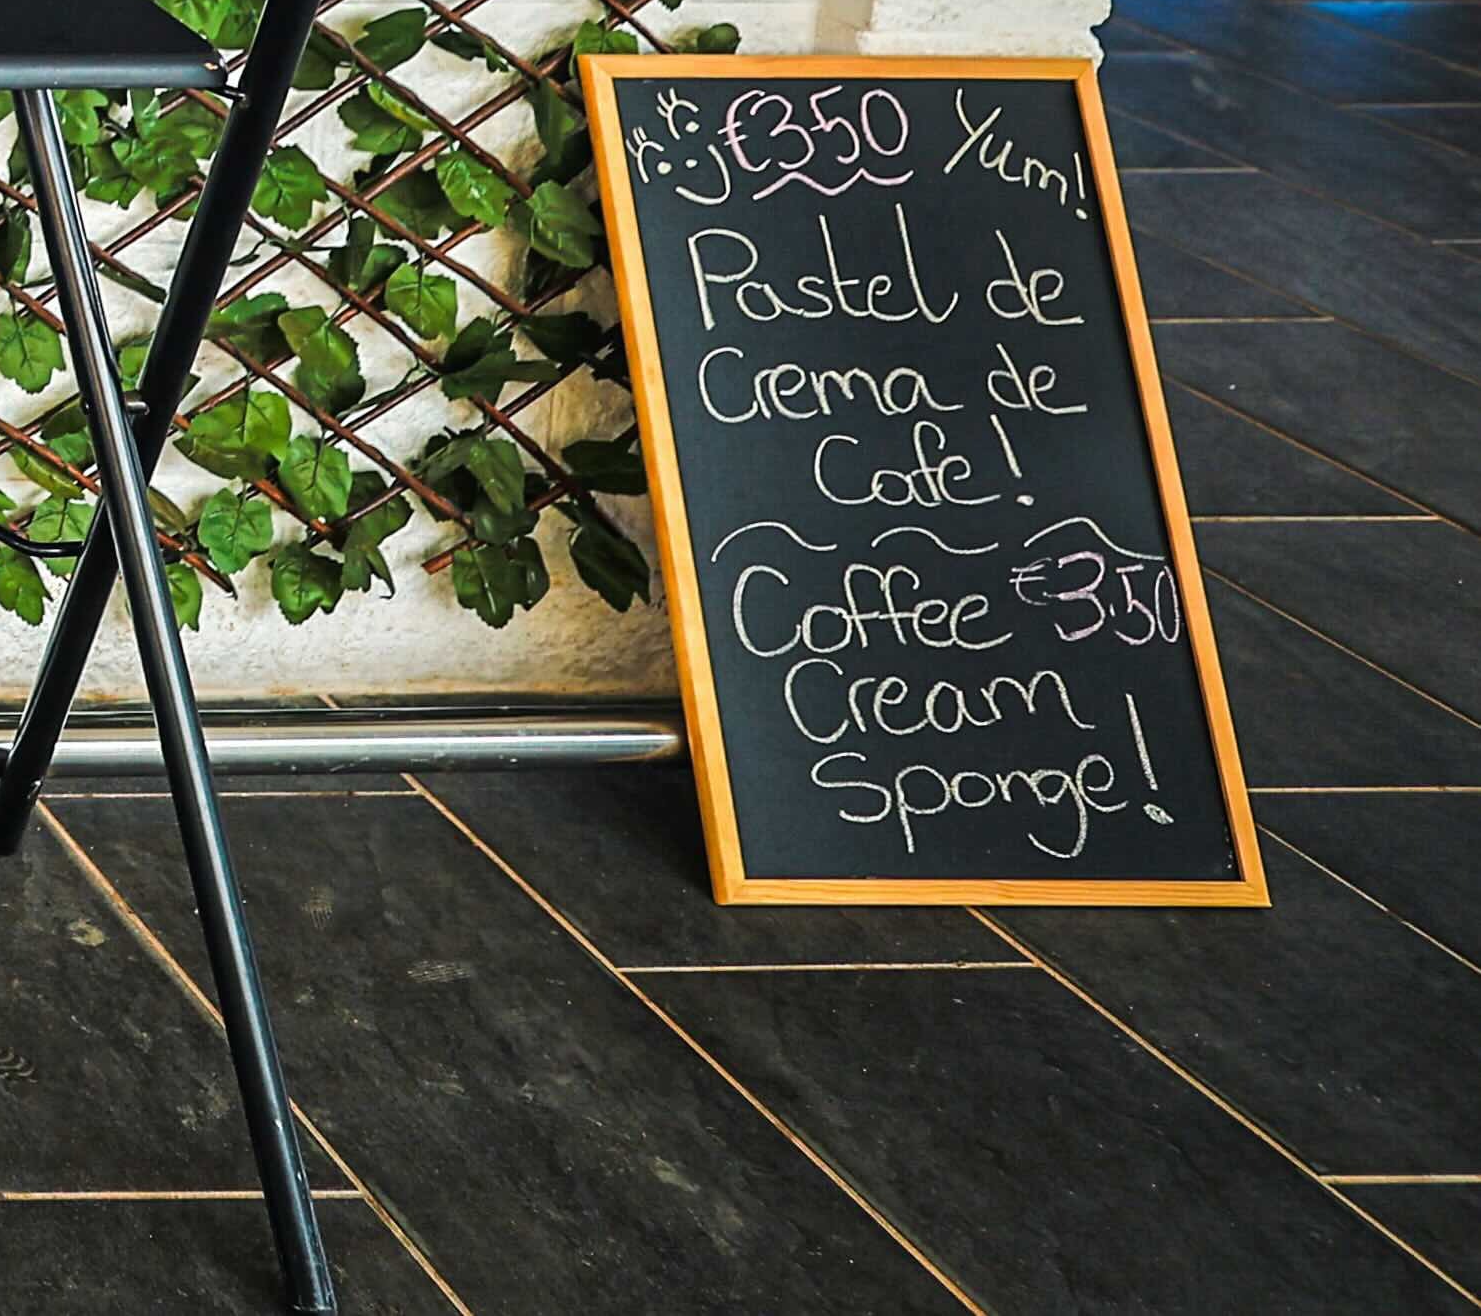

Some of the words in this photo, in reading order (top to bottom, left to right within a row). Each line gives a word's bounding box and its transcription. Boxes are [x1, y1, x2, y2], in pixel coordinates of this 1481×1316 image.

[943, 87, 1090, 221] Yum!
[686, 203, 959, 329] Pastel
[985, 230, 1085, 325] de
[697, 347, 963, 424] Crema
[986, 343, 1087, 413] de
[731, 564, 1012, 658] Coffee
[783, 659, 1096, 746] Cream
[810, 693, 1176, 861] Sponge!
